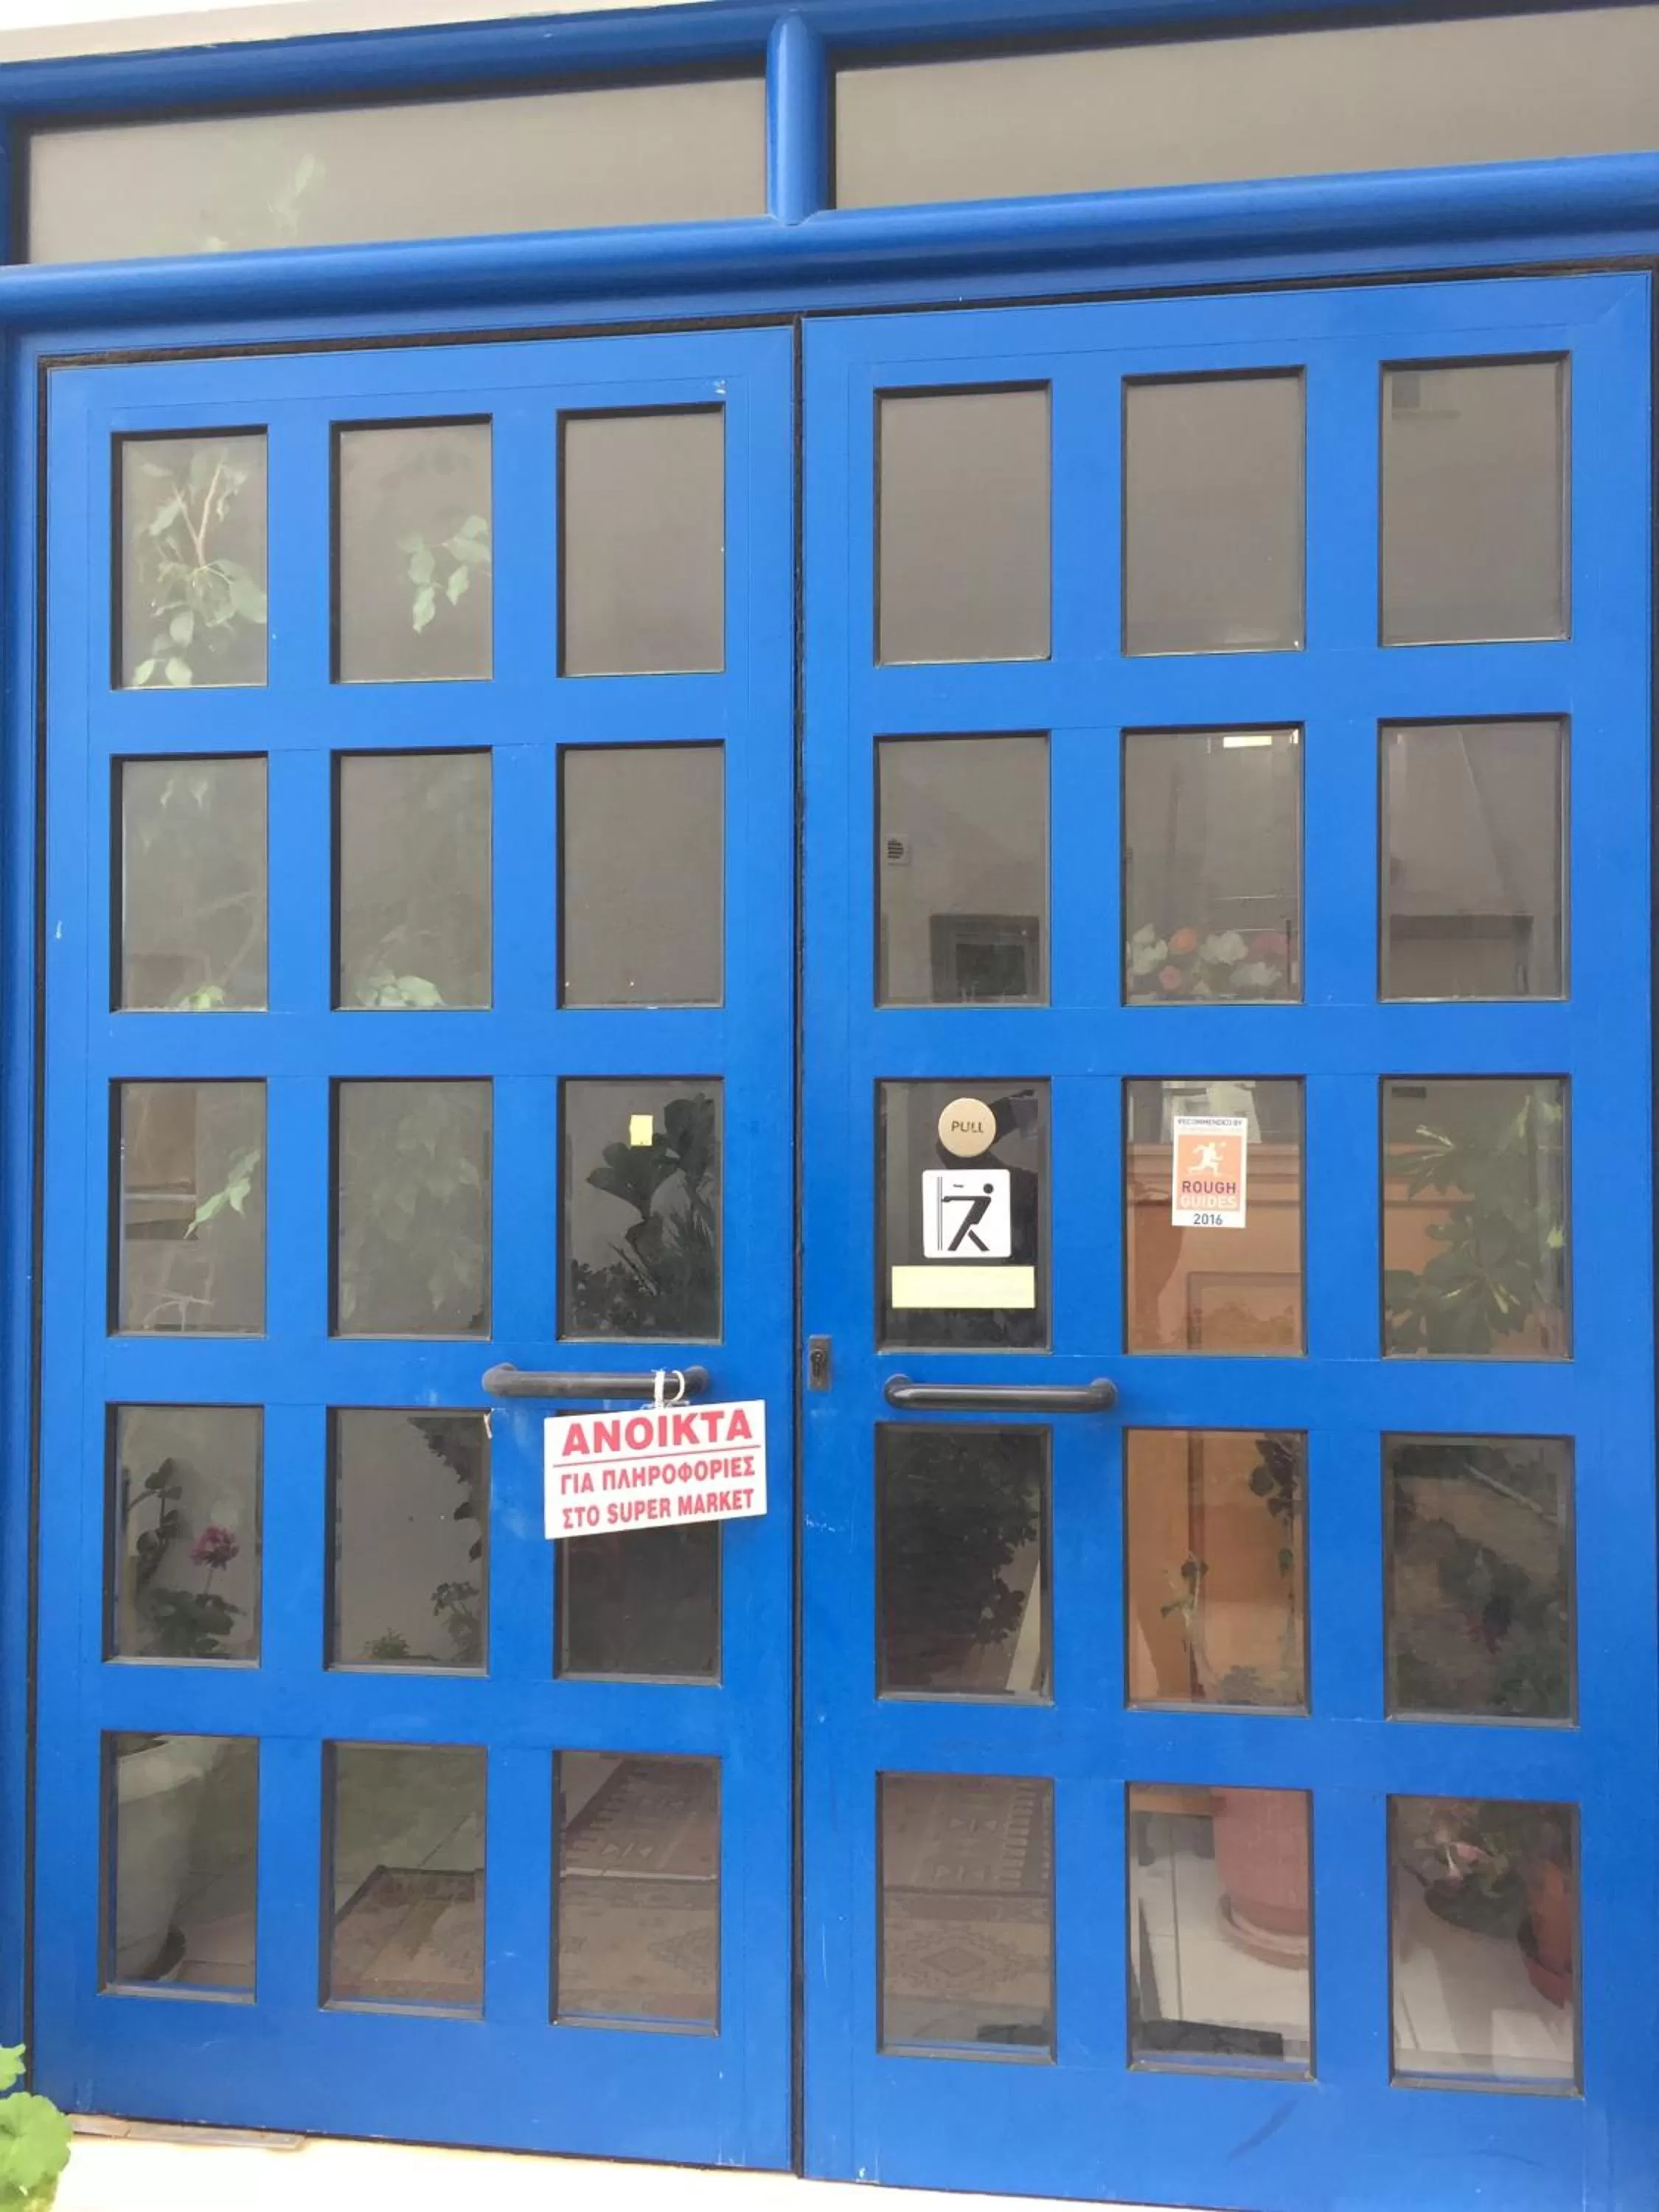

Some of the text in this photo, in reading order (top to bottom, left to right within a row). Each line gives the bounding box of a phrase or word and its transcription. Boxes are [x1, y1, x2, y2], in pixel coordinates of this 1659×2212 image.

[950, 1120, 984, 1133] PULL
[1182, 1180, 1236, 1194] ROUGH
[1180, 1194, 1237, 1209] GUIDES
[1193, 1214, 1223, 1225] 2016
[562, 1408, 753, 1457] ΑΝΟΙΚΤΑ
[561, 1456, 756, 1495] ΓΙΑ ΠΛΗΡΟΦΟΡΙΕΣ
[563, 1488, 754, 1529] ΣΤΟ SUPER MARKET
